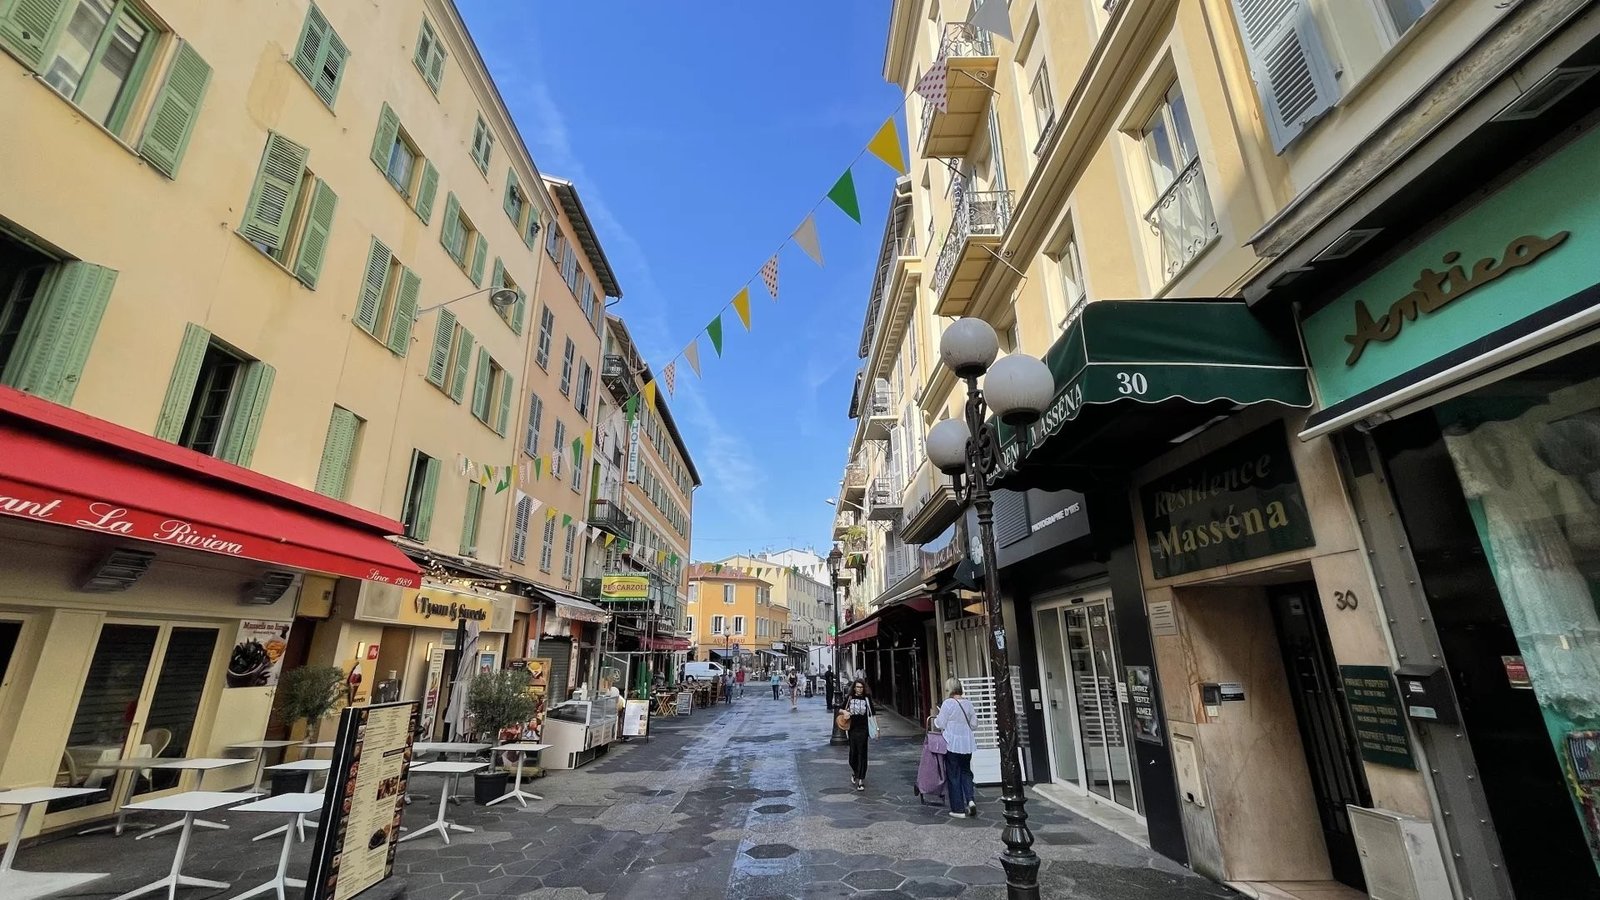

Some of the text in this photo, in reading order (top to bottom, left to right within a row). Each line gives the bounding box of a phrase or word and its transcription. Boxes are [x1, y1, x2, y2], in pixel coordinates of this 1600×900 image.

[1344, 230, 1571, 366] Antica
[1116, 372, 1148, 395] 30
[1155, 454, 1271, 519] Résidence
[76, 502, 133, 534] La
[153, 519, 243, 555] Riviera
[1155, 501, 1289, 559] Masséna
[366, 568, 413, 587] Since 1989
[1333, 589, 1359, 611] 30
[458, 603, 487, 621] Sweets
[1133, 695, 1151, 704] TESTEZ
[1136, 707, 1153, 716] AIMEZ
